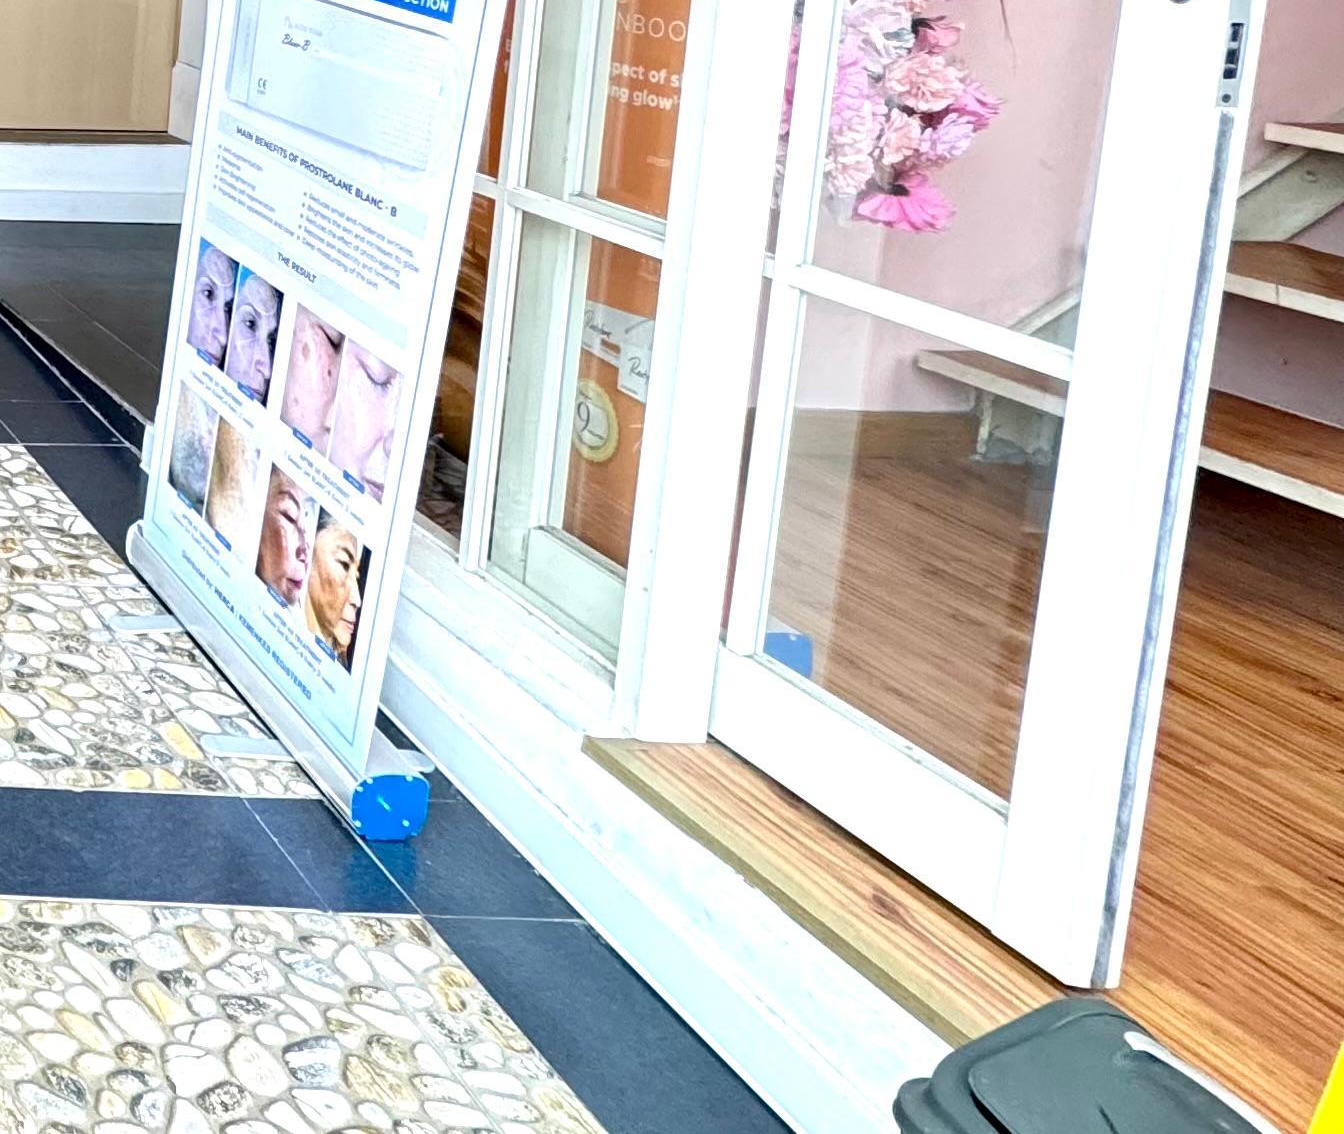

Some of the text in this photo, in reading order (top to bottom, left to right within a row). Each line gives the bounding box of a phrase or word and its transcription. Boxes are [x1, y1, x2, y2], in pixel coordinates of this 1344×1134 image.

[236, 125, 253, 141] MAIN
[255, 135, 288, 159] BENEFITS
[288, 152, 299, 163] OF
[300, 158, 353, 195] PROSTROLANE
[355, 187, 383, 210] BLANC
[277, 252, 317, 283] THE RESULT
